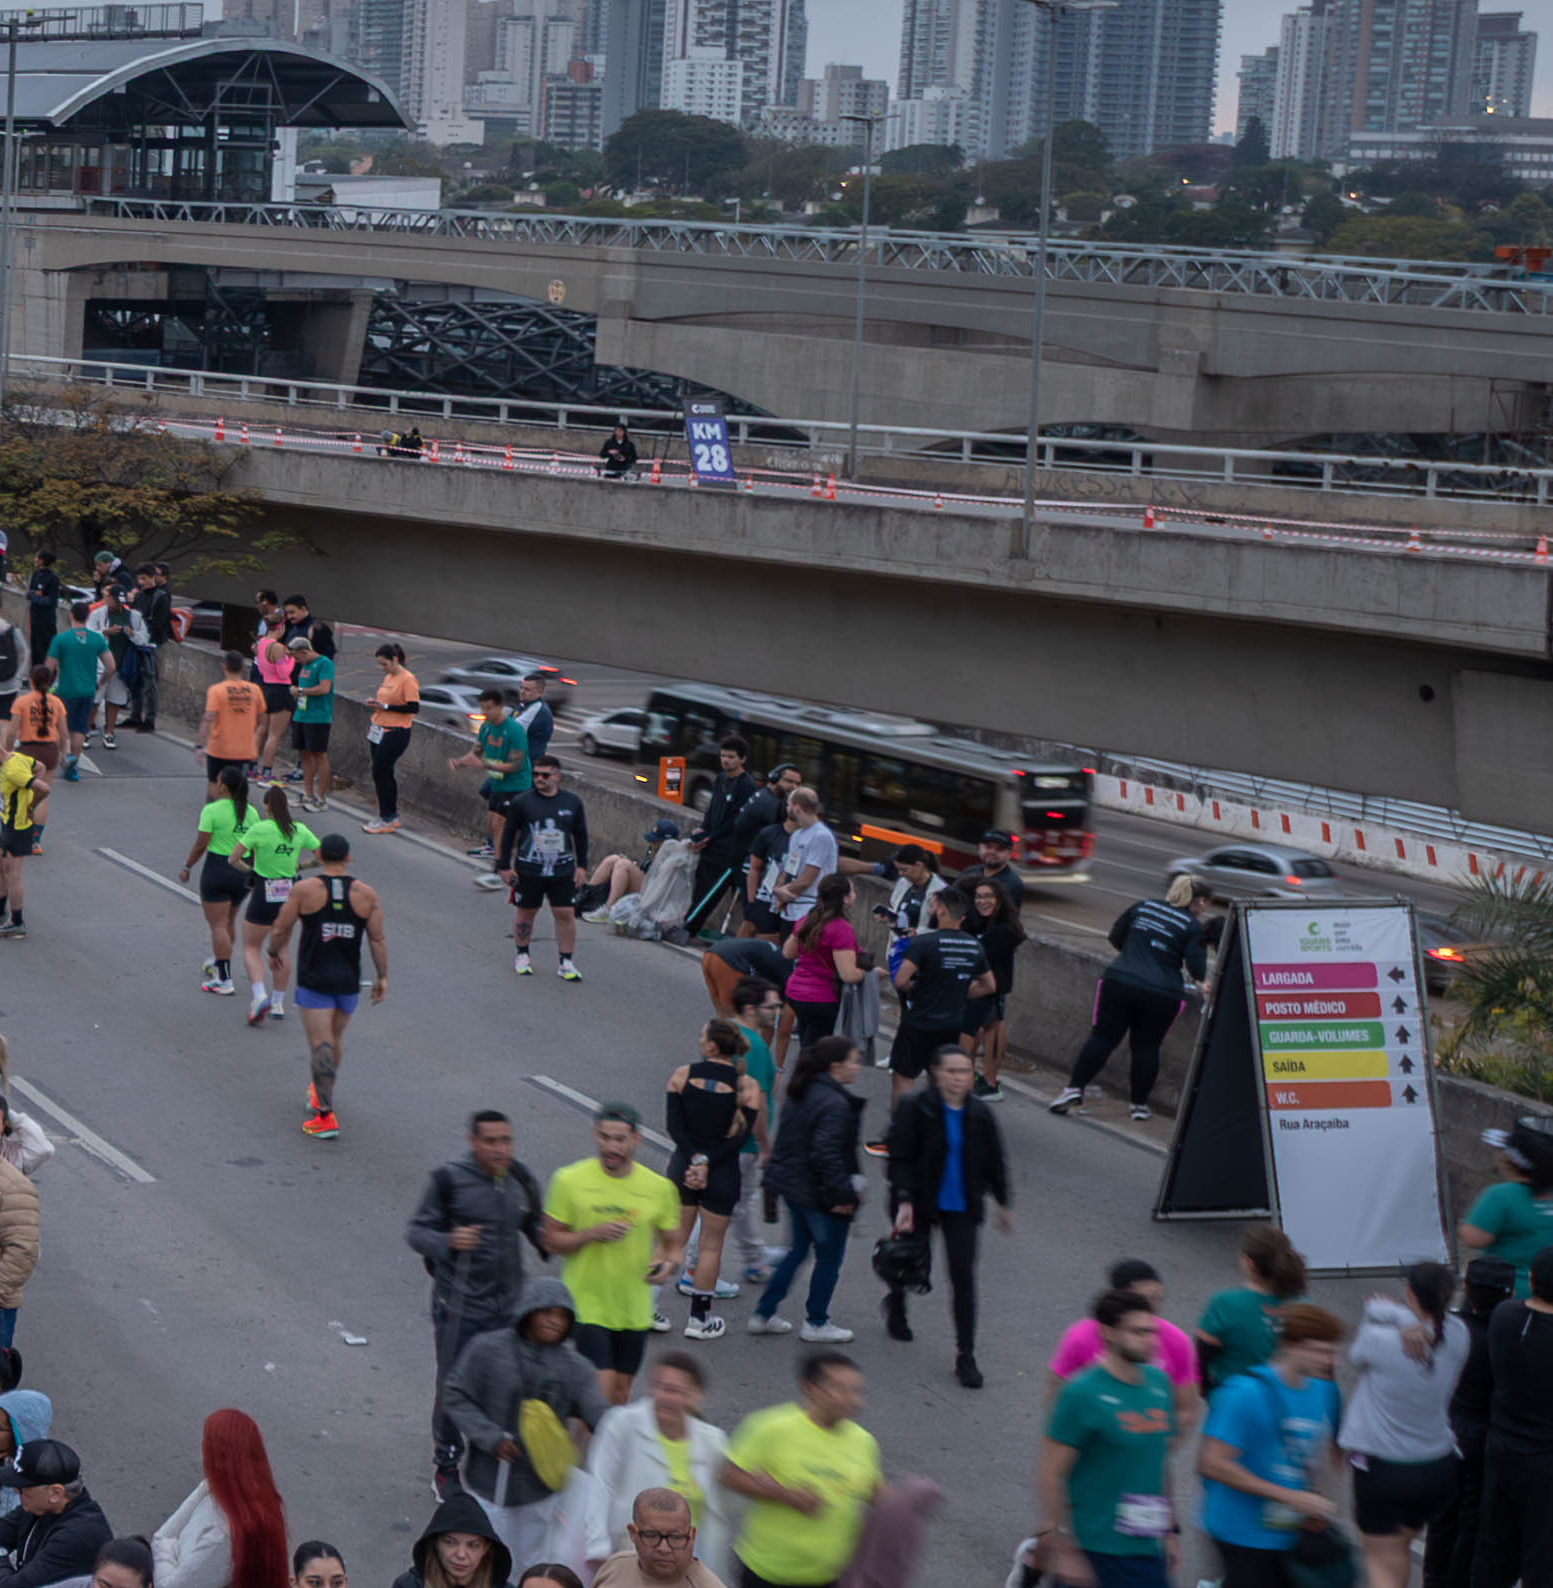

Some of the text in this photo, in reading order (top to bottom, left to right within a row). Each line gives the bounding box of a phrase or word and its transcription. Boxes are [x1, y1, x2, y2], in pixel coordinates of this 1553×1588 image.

[693, 422, 722, 440] KM
[695, 444, 728, 472] 28
[1262, 972, 1314, 986] LARGADA
[1265, 998, 1347, 1016] POSTO MÉDICO
[1268, 1029, 1370, 1044] GUARDA-VOLUMES
[1272, 1058, 1307, 1074] SAÍDA
[1276, 1091, 1300, 1104] W.C.
[1279, 1118, 1301, 1131] Rua
